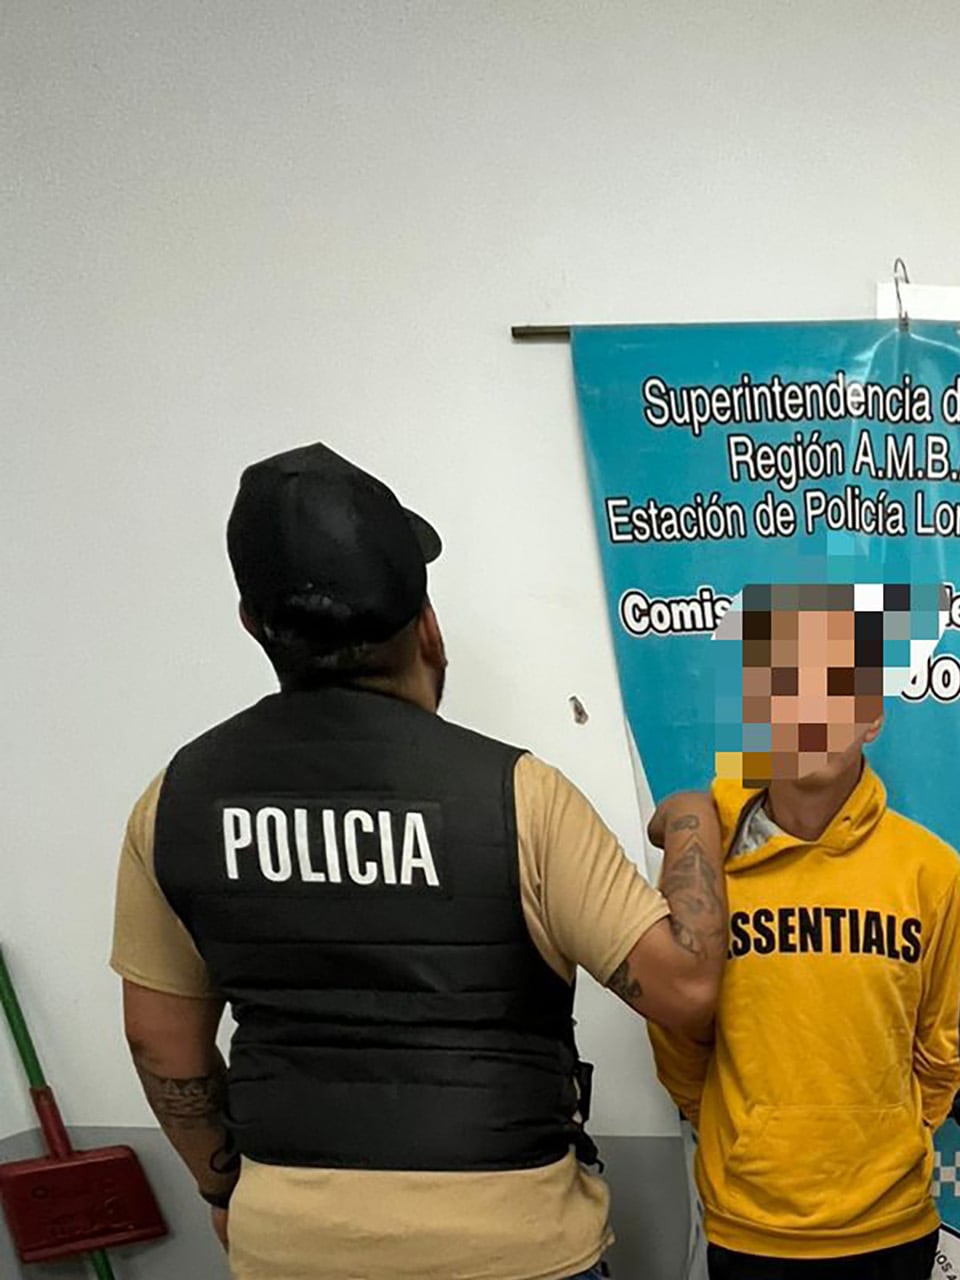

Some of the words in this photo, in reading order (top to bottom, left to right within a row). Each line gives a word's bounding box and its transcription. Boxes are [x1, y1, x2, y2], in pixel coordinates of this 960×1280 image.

[643, 371, 934, 432] Superintendencia
[728, 434, 844, 485] Región
[606, 500, 746, 543] Estación
[753, 497, 796, 538] de
[804, 487, 907, 535] Policía
[222, 806, 440, 887] POLICIA
[727, 907, 922, 963] SSENTIALS
